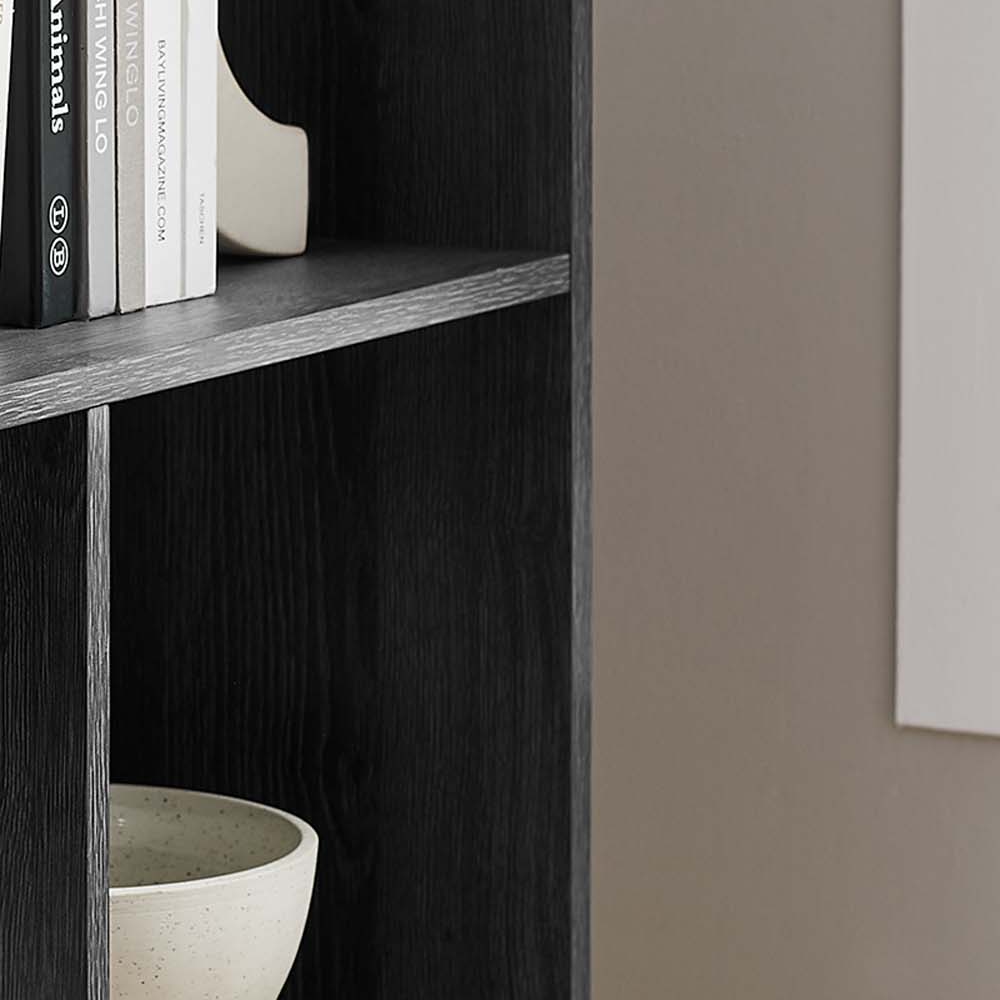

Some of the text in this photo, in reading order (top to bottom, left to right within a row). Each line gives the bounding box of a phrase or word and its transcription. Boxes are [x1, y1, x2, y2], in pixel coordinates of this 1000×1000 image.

[94, 36, 108, 110] WING
[94, 117, 108, 154] LO
[156, 39, 167, 242] BAYLIVINGMAGAZINE.COM
